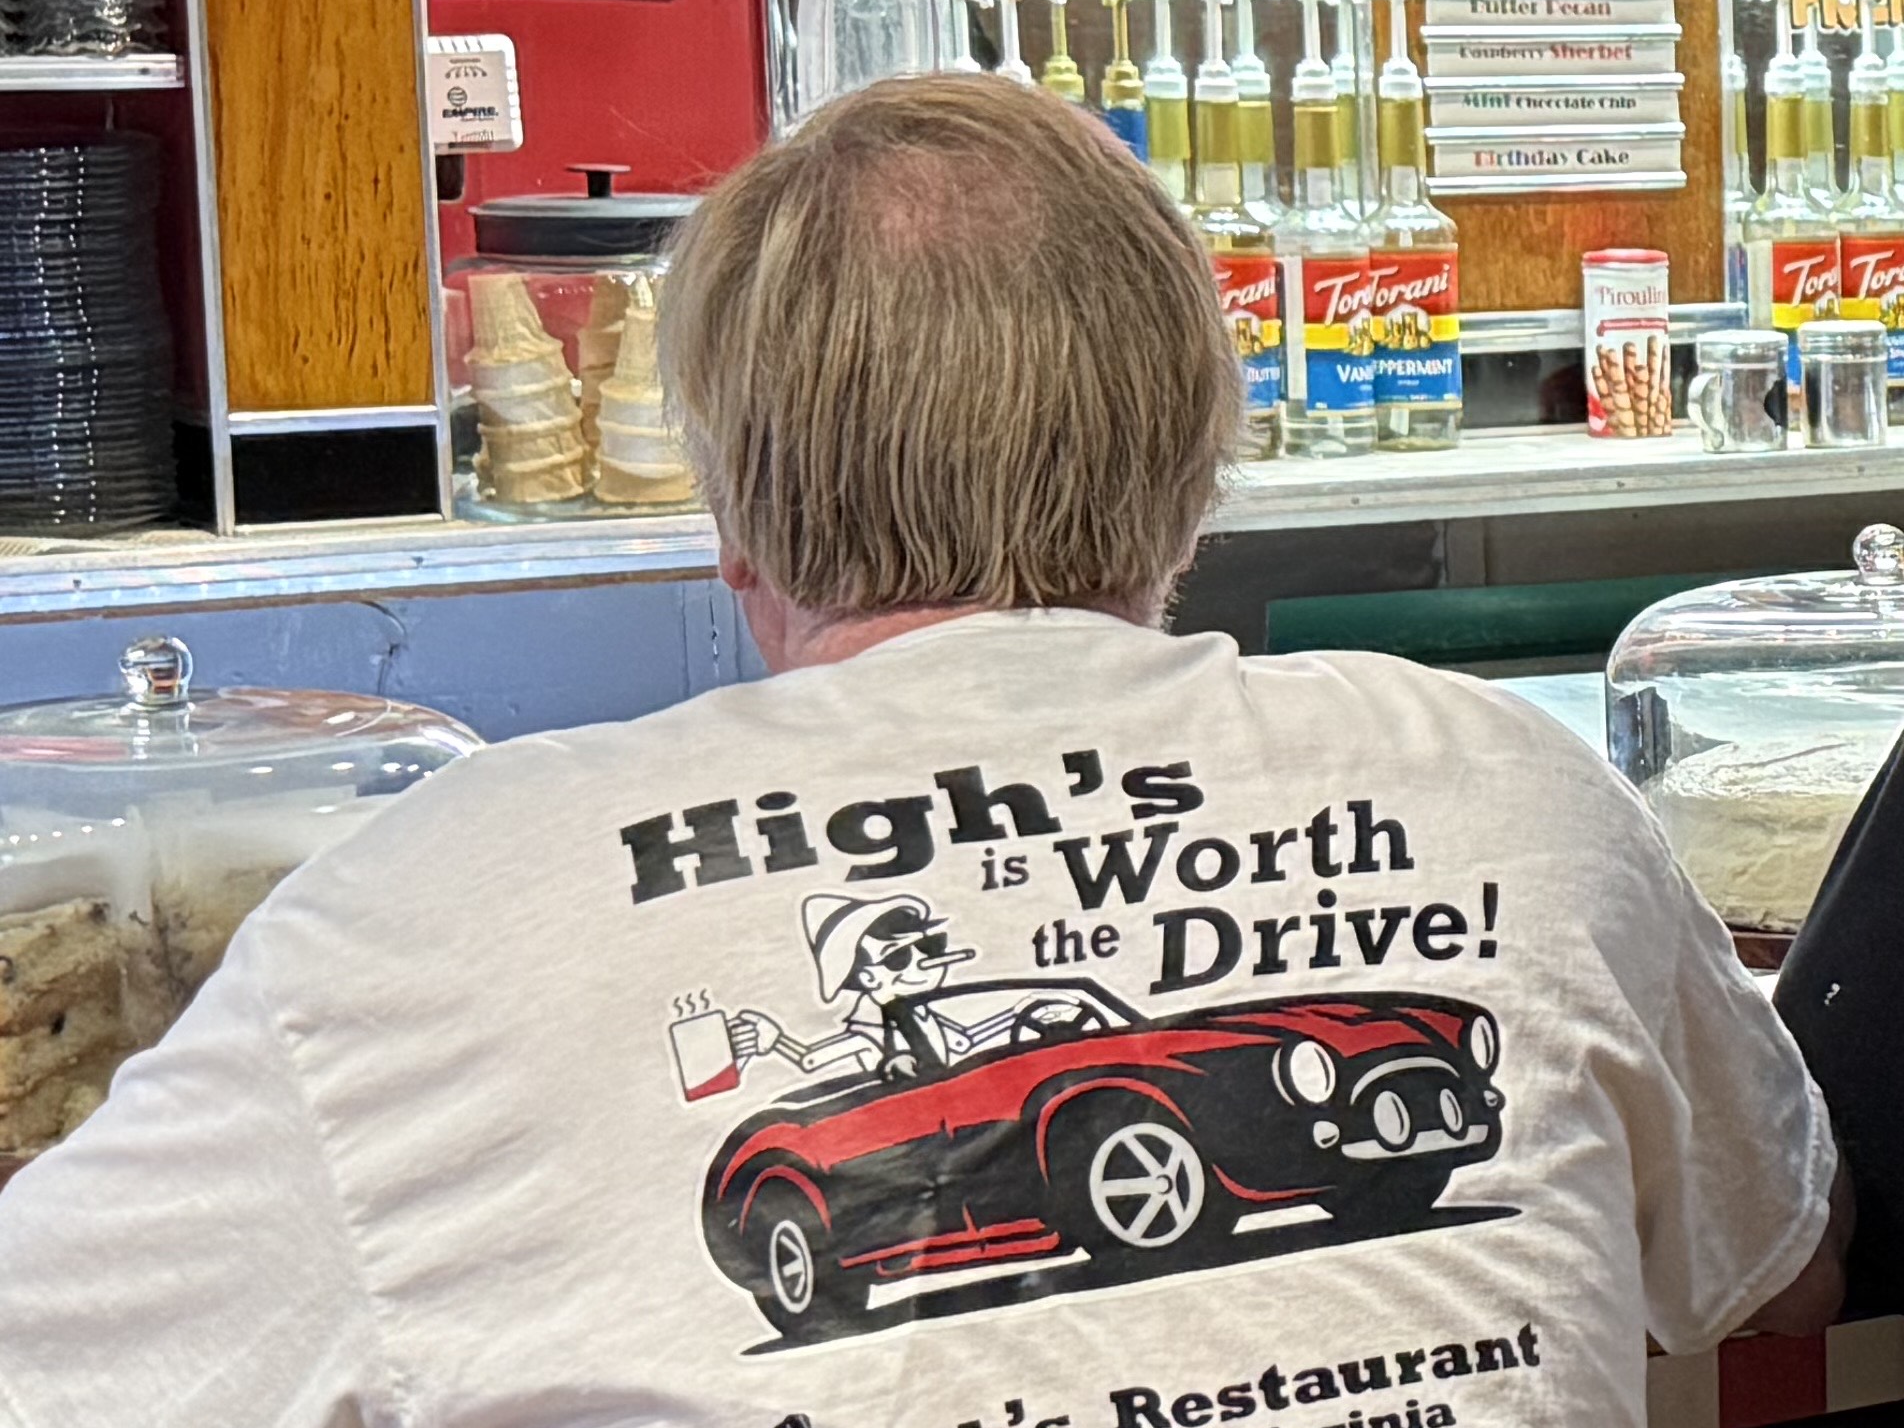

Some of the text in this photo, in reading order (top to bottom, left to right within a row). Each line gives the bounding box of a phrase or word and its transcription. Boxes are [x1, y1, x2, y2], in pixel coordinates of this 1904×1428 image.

[1549, 42, 1633, 61] Sherbet
[1473, 148, 1630, 167] Birthday Cake
[619, 749, 1206, 905] High's
[980, 799, 1415, 912] is Worth
[1031, 882, 1501, 996] the Drive!
